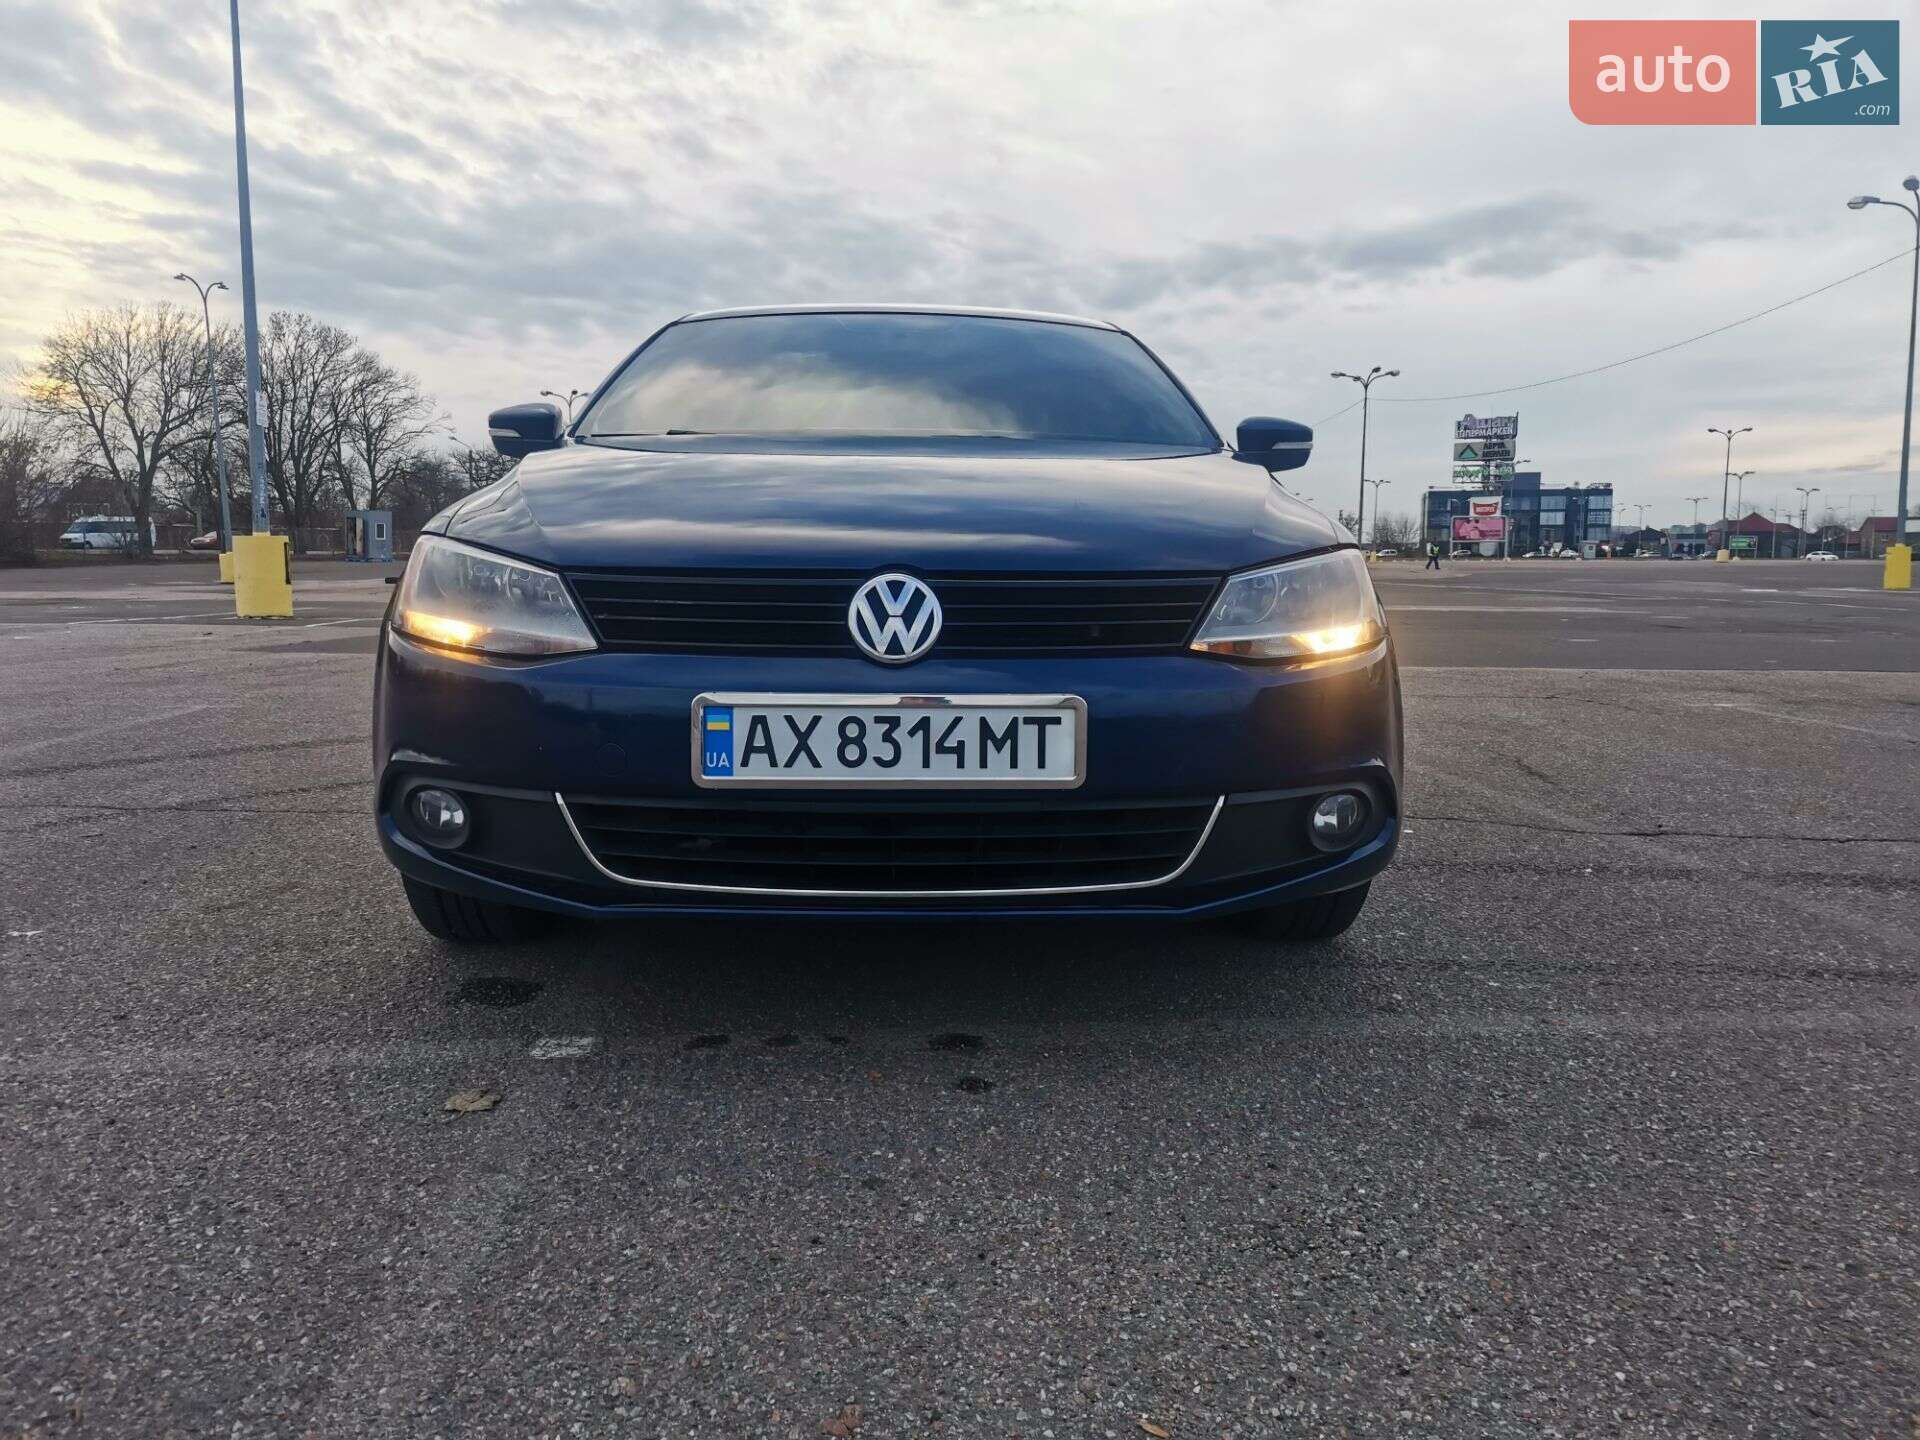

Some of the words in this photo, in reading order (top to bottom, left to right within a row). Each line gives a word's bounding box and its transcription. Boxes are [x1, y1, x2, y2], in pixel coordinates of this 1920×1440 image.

[740, 714, 823, 768] AX
[836, 714, 966, 769] 8314
[979, 716, 1062, 769] MT
[706, 752, 730, 768] UA
